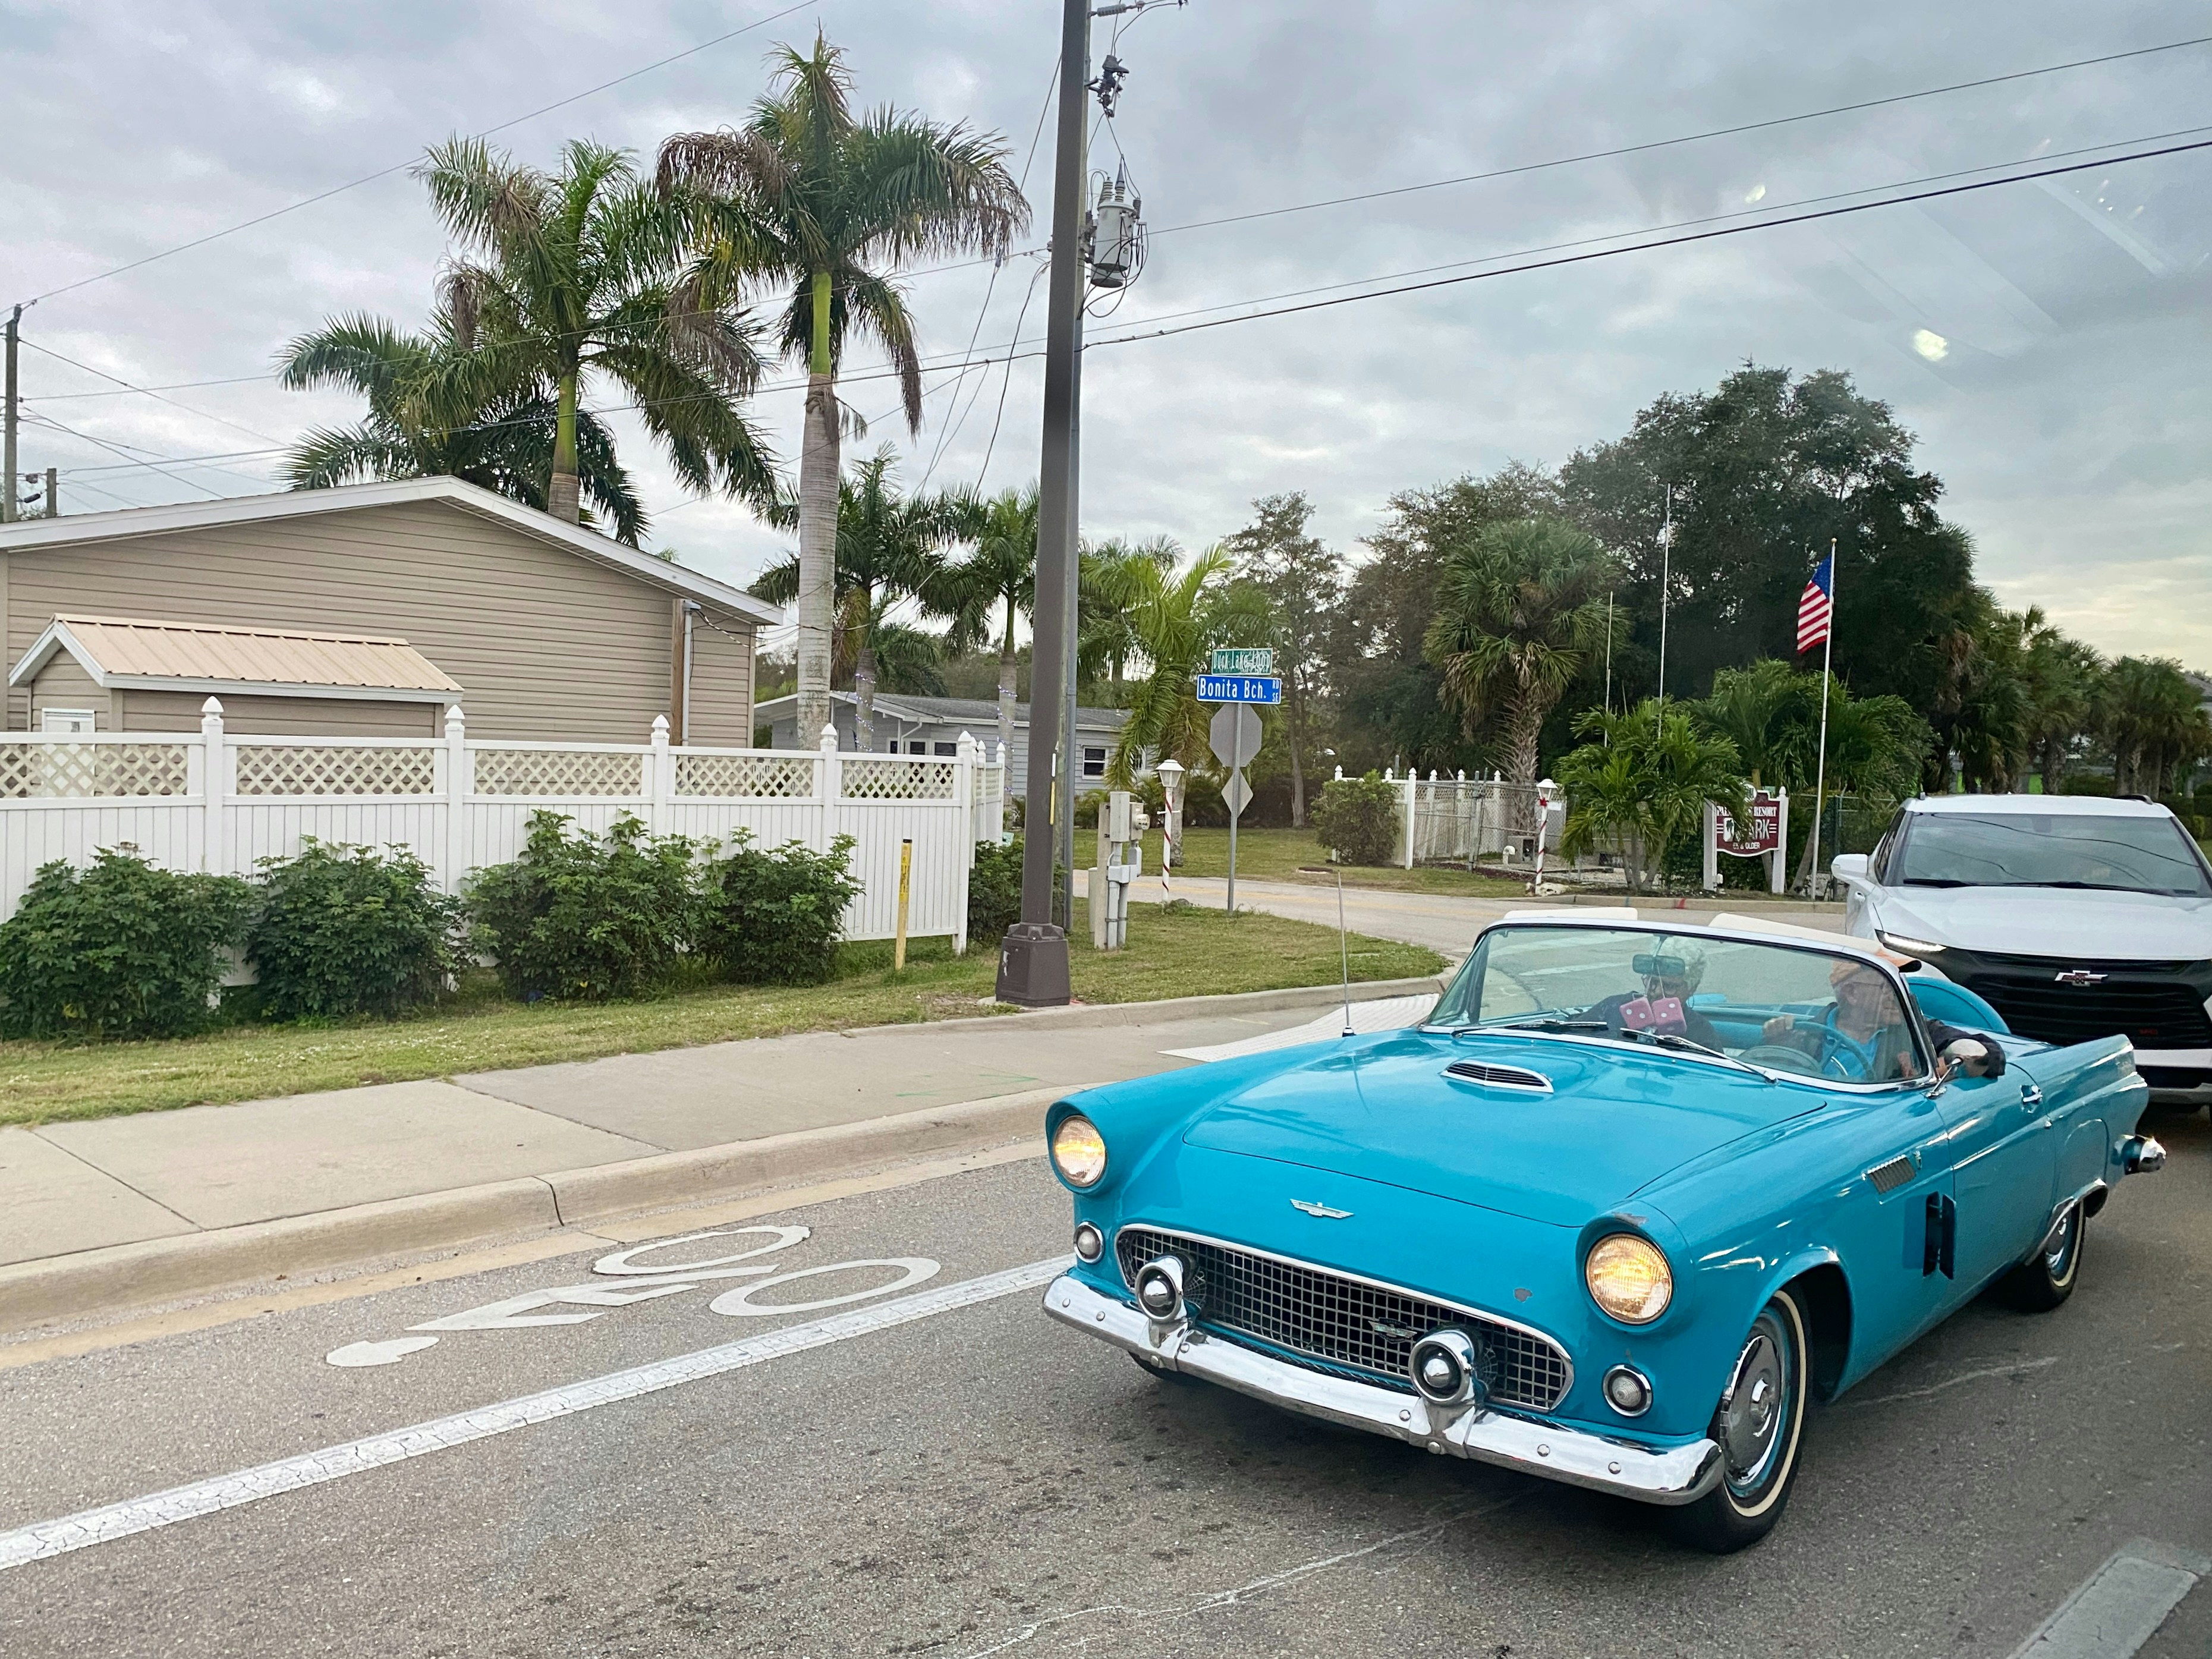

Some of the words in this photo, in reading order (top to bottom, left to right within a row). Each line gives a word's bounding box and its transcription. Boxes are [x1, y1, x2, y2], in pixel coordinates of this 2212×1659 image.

[1213, 651, 1228, 669] Duck
[1231, 650, 1248, 669] Lake
[1200, 678, 1237, 697] Bonita
[1244, 680, 1267, 699] Bch.
[1272, 679, 1279, 690] RD
[1272, 692, 1279, 701] SE
[1754, 807, 1777, 817] RESORT
